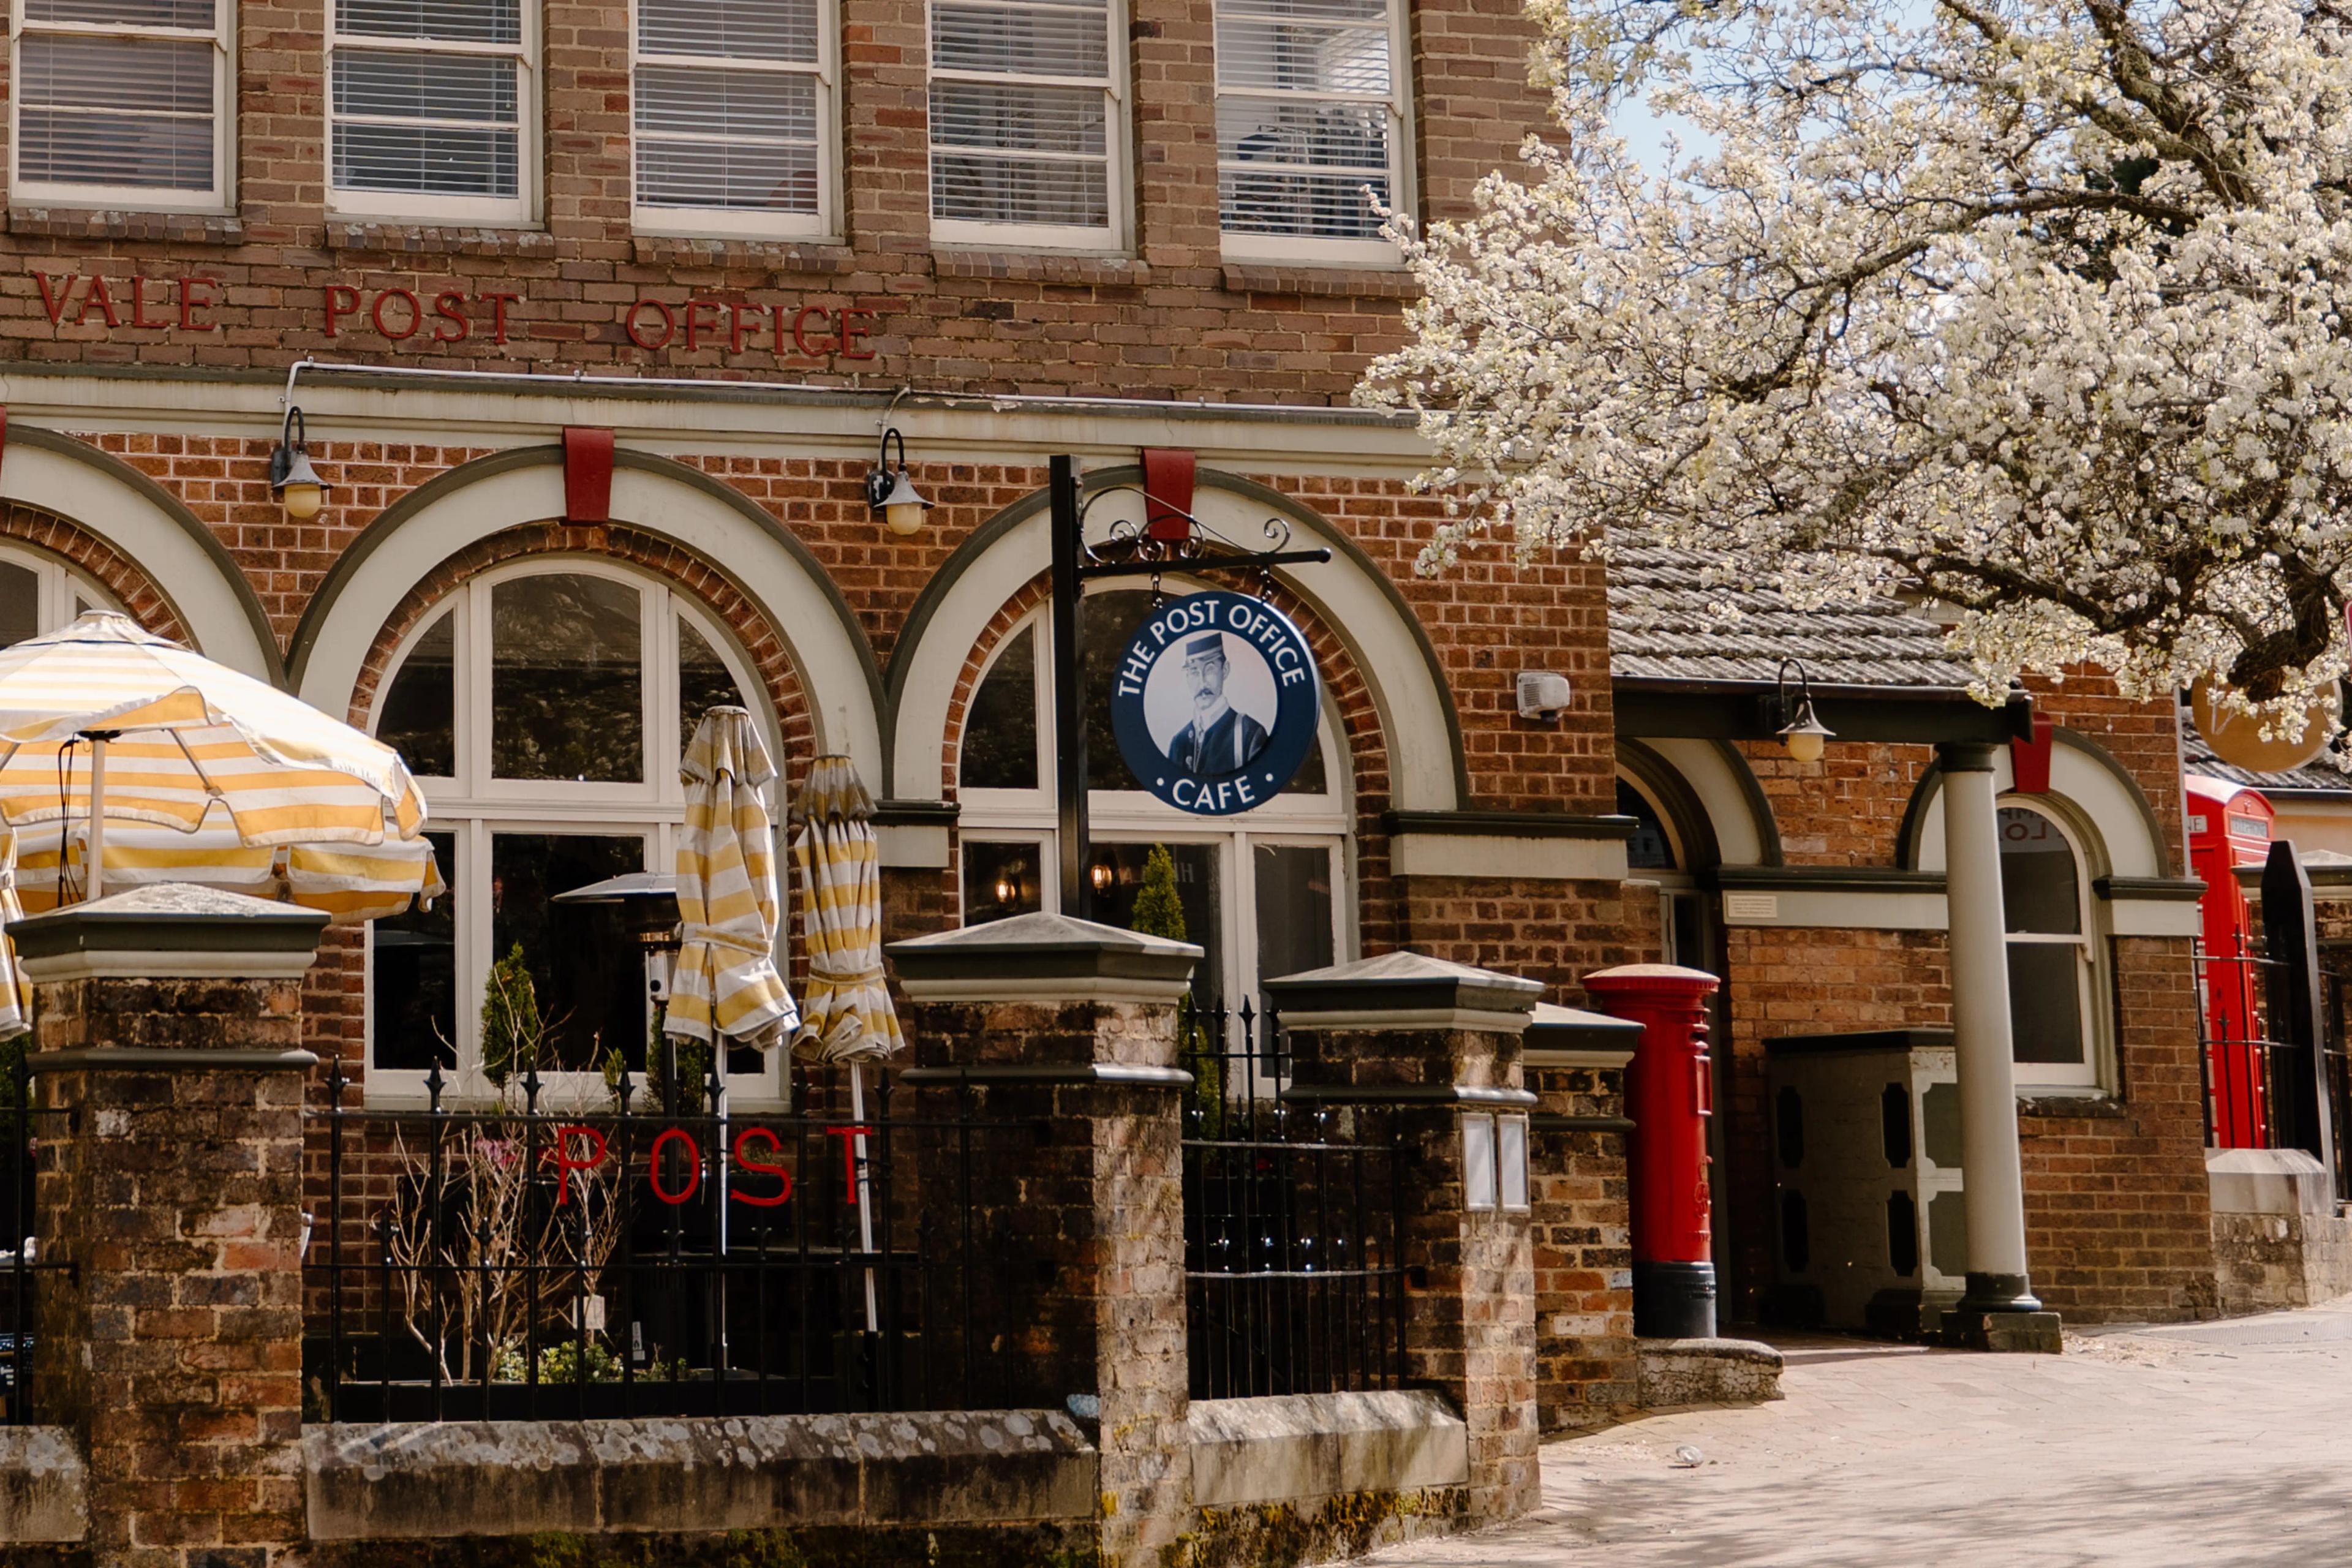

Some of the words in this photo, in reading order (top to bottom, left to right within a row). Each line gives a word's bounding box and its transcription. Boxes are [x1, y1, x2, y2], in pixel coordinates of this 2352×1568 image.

[31, 271, 217, 331] VALE
[323, 285, 520, 345] POST
[626, 298, 876, 360] OFFICE
[1118, 641, 1155, 697] THE
[1150, 600, 1219, 645] POST
[1229, 605, 1306, 687] OFFICE
[1172, 775, 1255, 810] CAFE
[557, 1126, 872, 1207] POST
